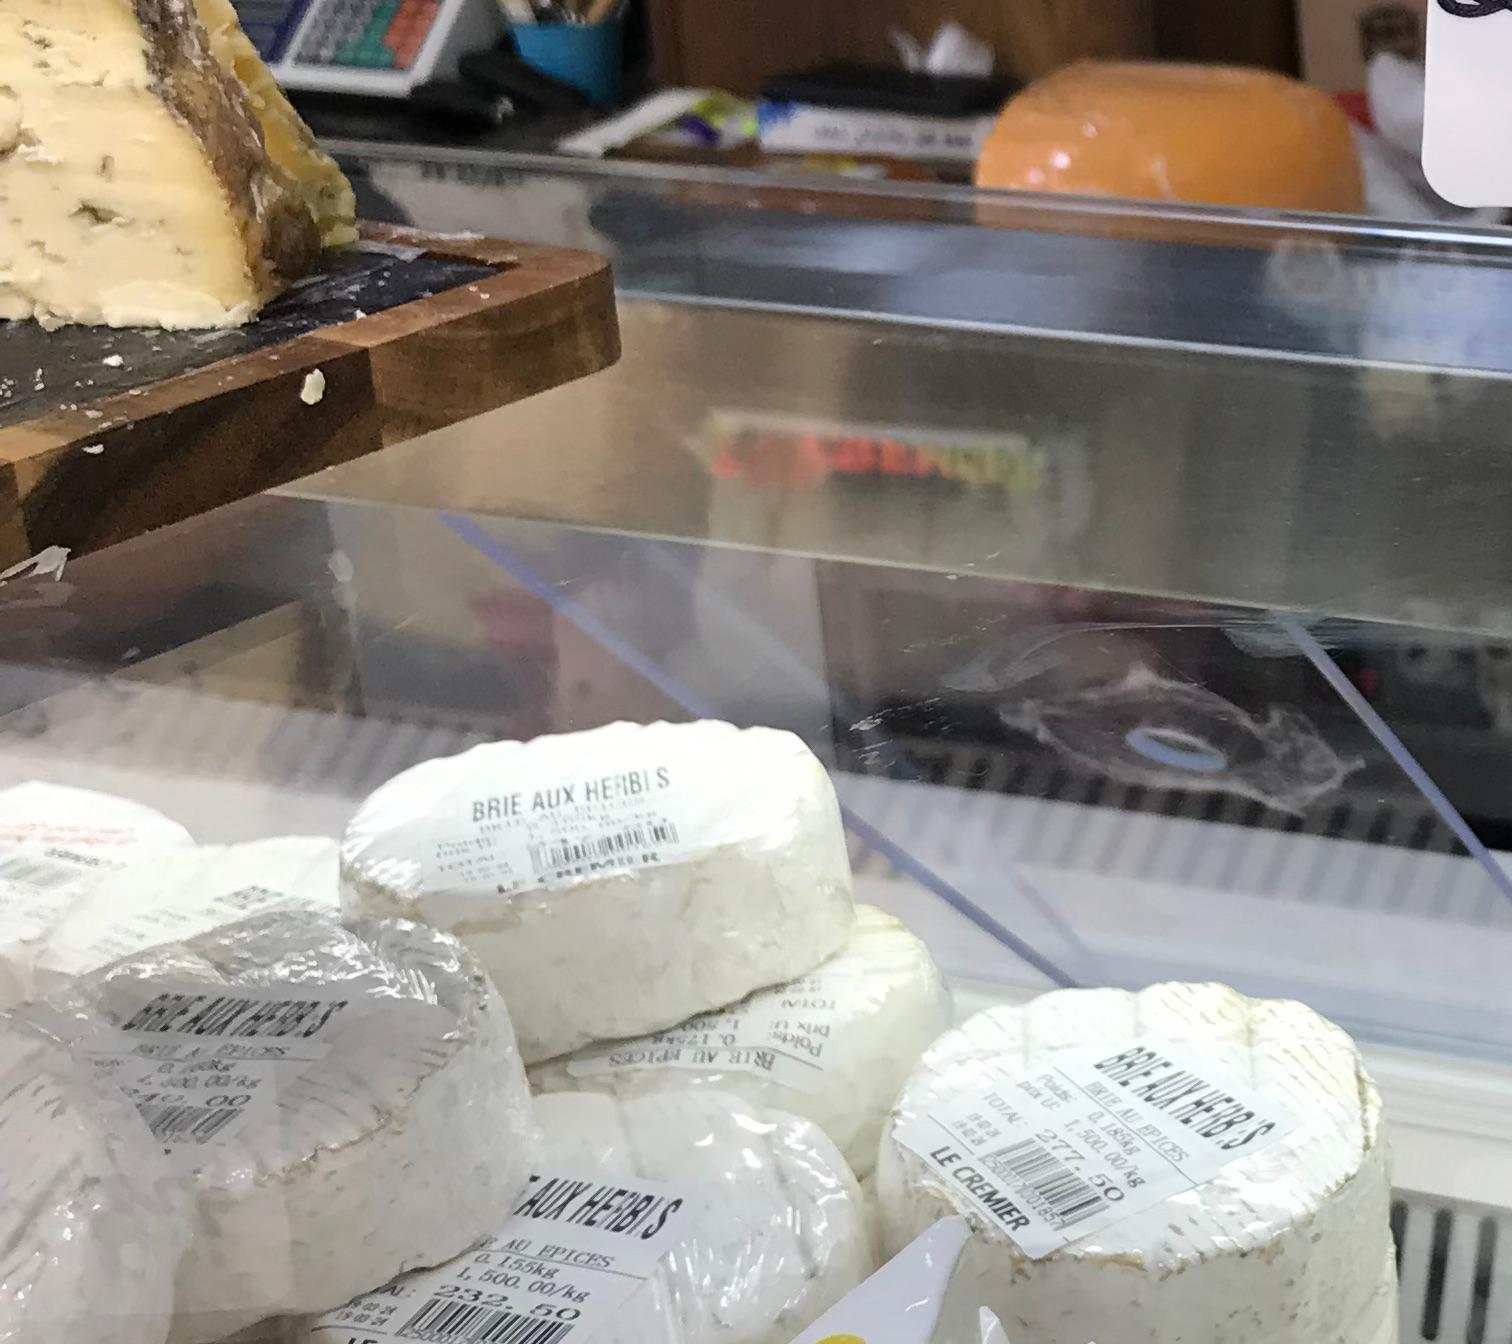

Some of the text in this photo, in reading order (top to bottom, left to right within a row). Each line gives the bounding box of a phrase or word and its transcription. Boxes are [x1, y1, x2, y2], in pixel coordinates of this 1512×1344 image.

[472, 793, 523, 823] BRIE
[531, 785, 576, 812] AUX
[513, 1177, 591, 1222] AUX
[930, 1145, 1031, 1233] LE CREMIER
